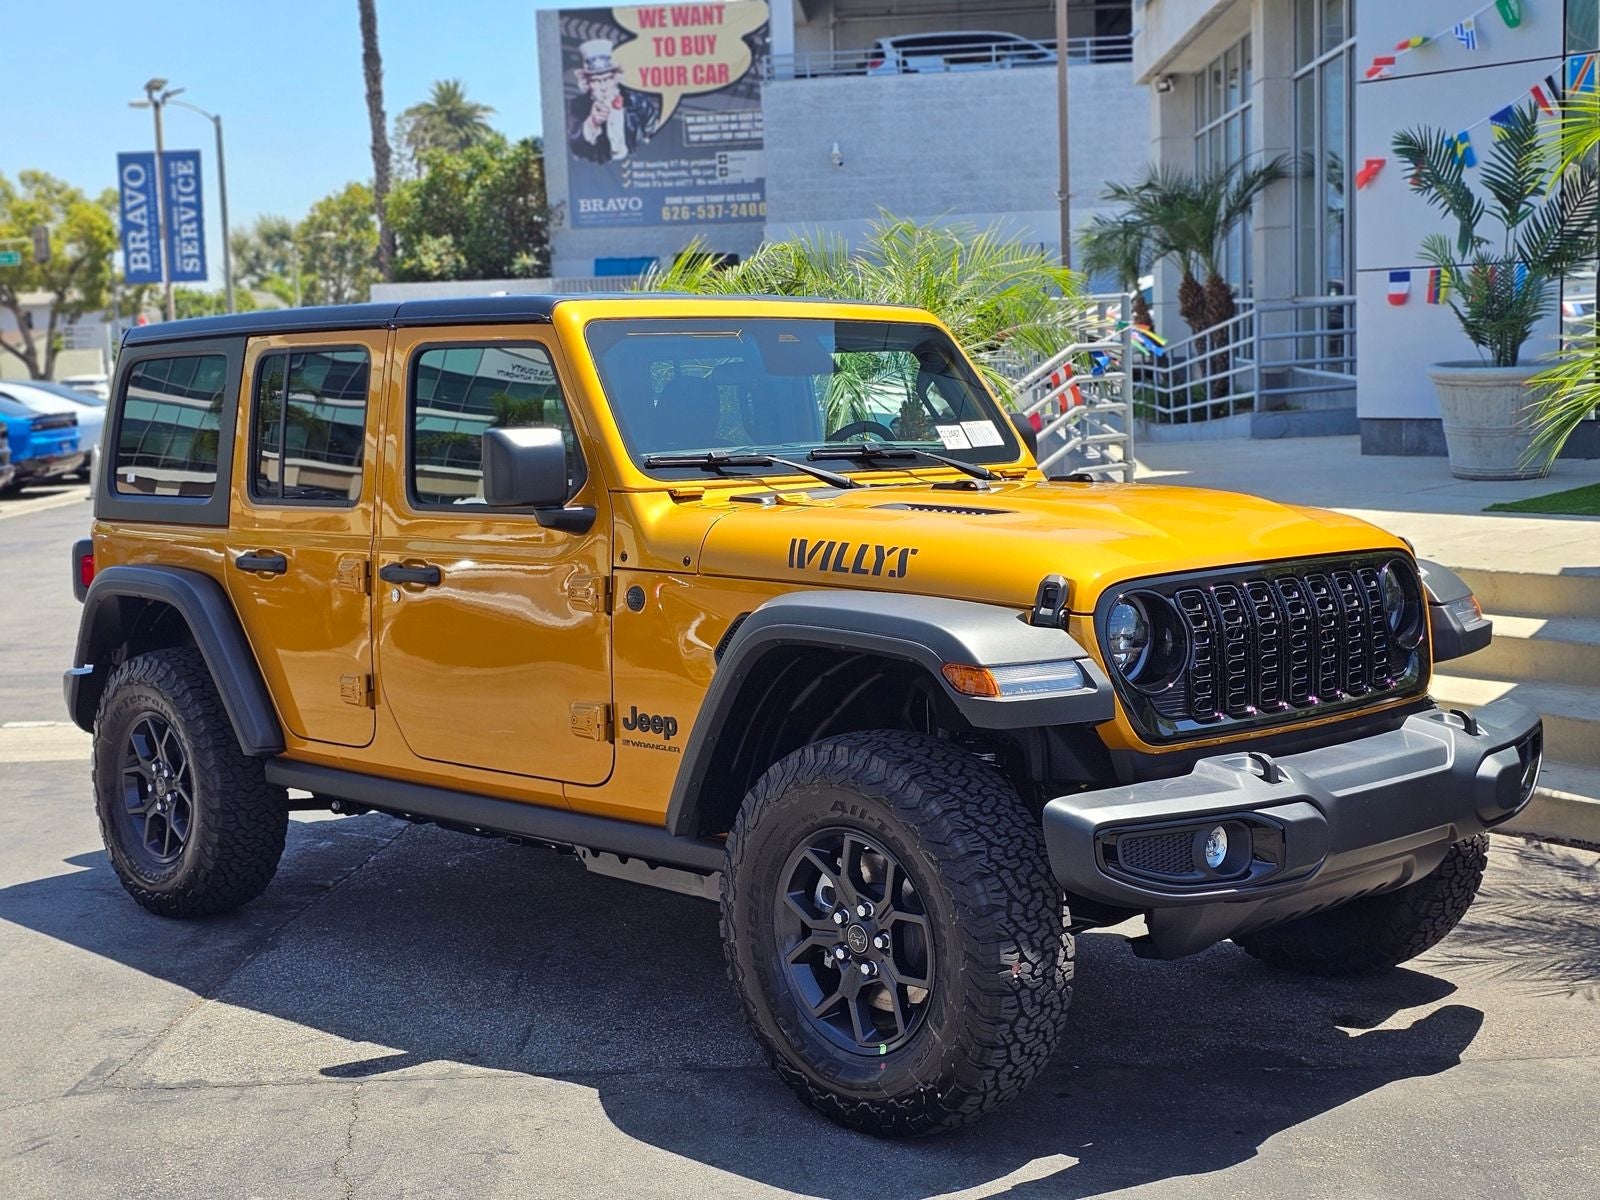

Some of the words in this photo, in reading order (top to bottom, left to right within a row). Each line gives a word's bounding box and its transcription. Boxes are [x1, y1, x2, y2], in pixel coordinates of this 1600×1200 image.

[638, 8, 666, 28] WE
[670, 5, 726, 27] WANT
[652, 36, 677, 58] TO
[681, 34, 717, 57] BUY
[639, 66, 688, 87] YOUR
[692, 63, 730, 86] CAR
[177, 160, 200, 273] SERVICE
[579, 197, 643, 212] BRAVO
[662, 203, 766, 220] 626-537-2400
[123, 164, 151, 273] BRAVO
[788, 538, 919, 578] WILLYS
[622, 705, 678, 741] Jeep
[630, 740, 681, 754] WRANGLER
